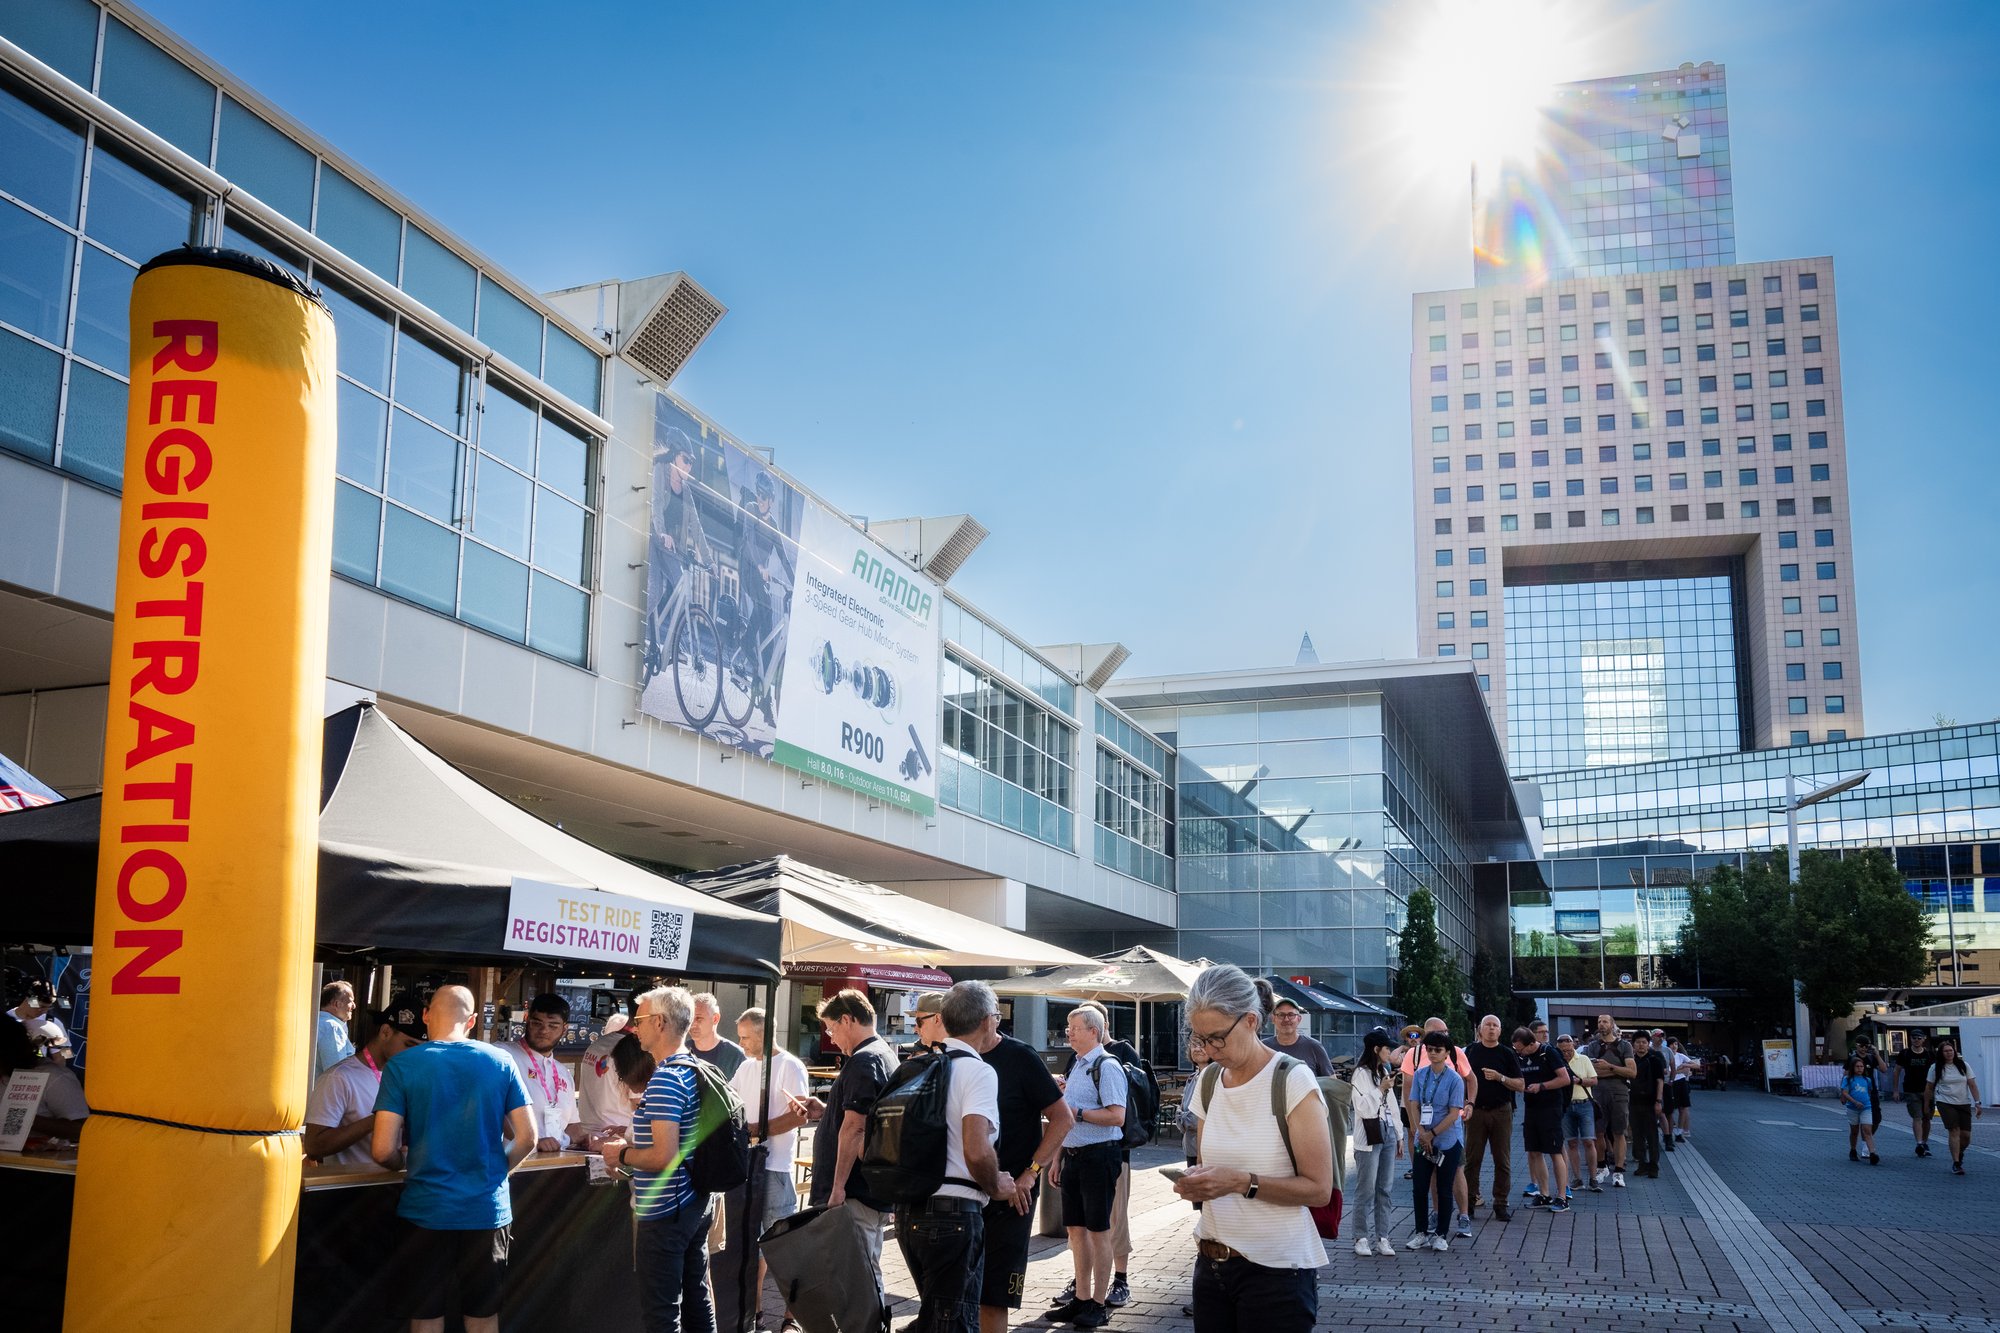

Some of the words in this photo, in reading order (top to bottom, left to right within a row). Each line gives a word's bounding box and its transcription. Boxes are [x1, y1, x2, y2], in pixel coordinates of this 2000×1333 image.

[805, 571, 848, 607] Integrated
[848, 597, 885, 629] Electronic
[851, 548, 933, 621] ANANDA
[804, 589, 838, 619] 3-Speed
[838, 609, 857, 629] Gear
[857, 620, 873, 639] Hub
[873, 630, 895, 651] Motor
[895, 641, 920, 665] System
[110, 319, 220, 996] REGISTRATION
[841, 721, 884, 763] R900
[807, 756, 820, 771] Hall
[820, 761, 833, 778] 8.0,
[848, 772, 873, 790] Outdoor
[872, 782, 886, 794] Area
[558, 898, 600, 924] TEST
[604, 906, 642, 930] RIDE
[511, 918, 640, 954] REGISTRATION
[8, 1092, 38, 1101] CHECK-IN
[11, 1084, 26, 1092] TEST
